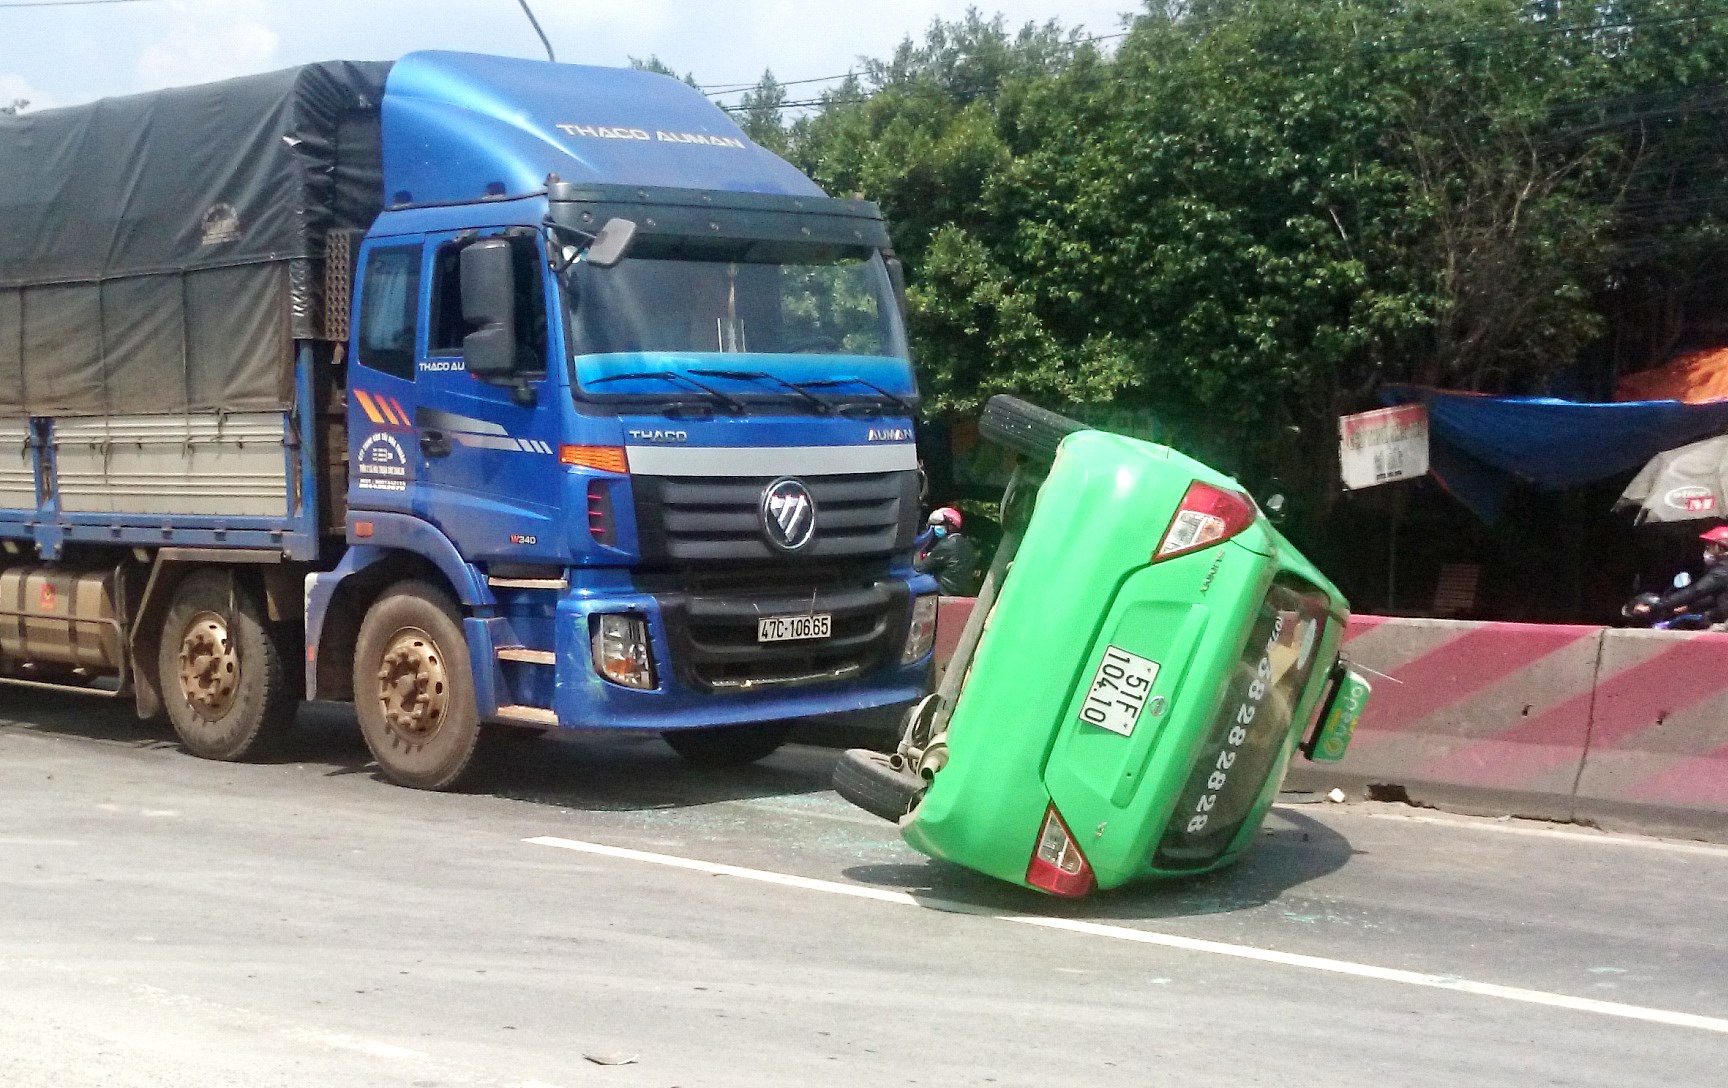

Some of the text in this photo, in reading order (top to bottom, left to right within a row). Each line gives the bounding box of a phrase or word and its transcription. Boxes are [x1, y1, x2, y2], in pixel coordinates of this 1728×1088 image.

[555, 123, 746, 149] THACO AUMAN
[419, 361, 449, 372] THACO
[628, 430, 688, 442] THACO
[868, 429, 913, 441] AUMAN
[510, 534, 537, 544] W340
[761, 617, 829, 639] 47C-106.65
[1084, 653, 1131, 723] 104.10
[1117, 673, 1150, 718] 51F
